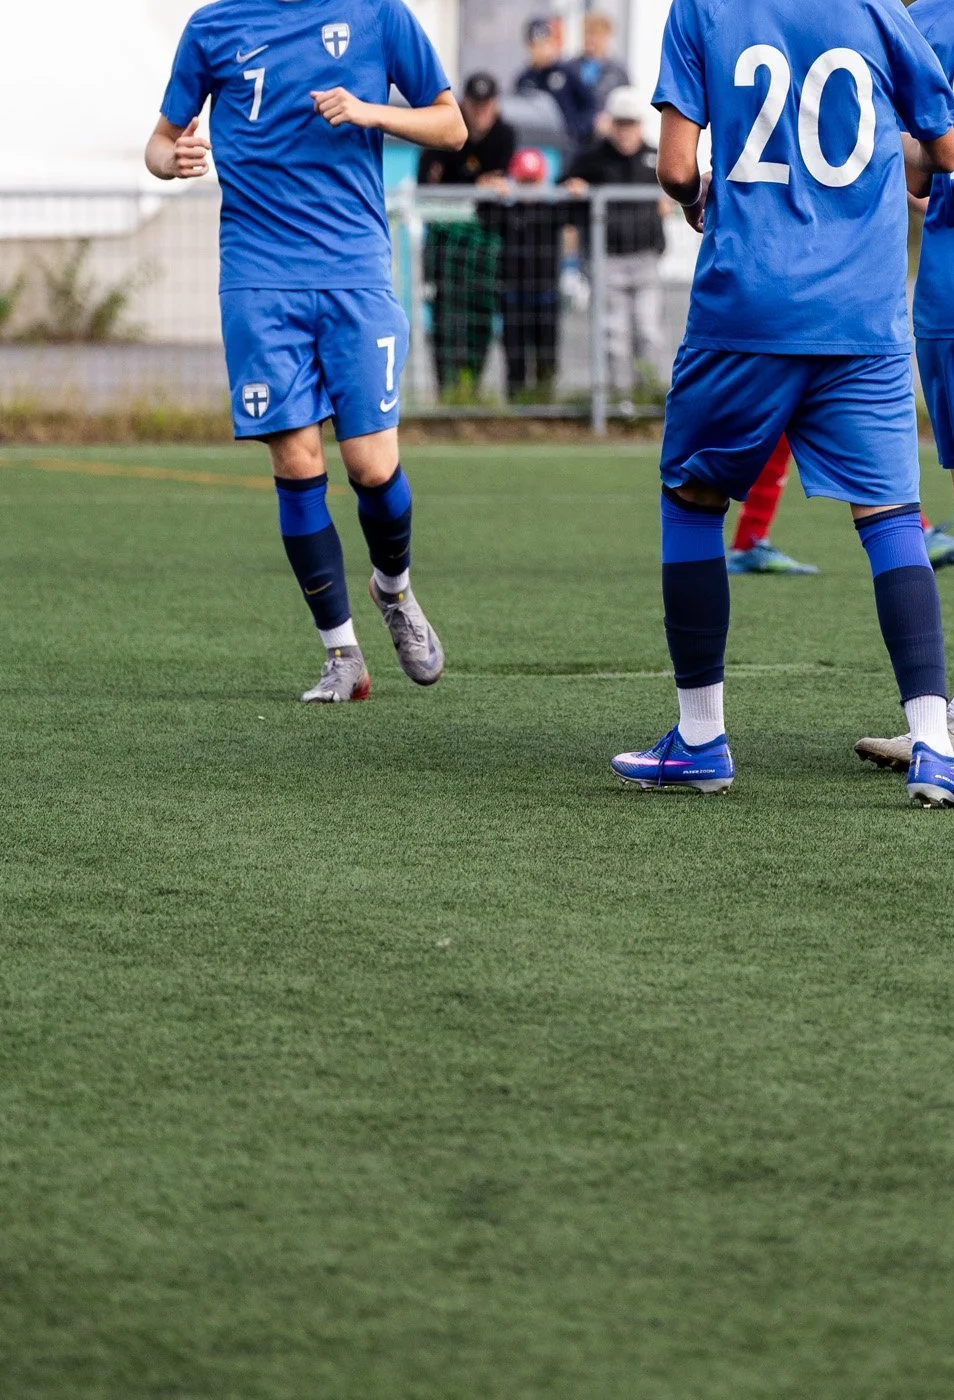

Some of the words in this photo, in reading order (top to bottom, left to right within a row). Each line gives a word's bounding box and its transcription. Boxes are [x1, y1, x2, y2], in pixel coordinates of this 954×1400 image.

[243, 67, 265, 121] 7
[726, 43, 876, 187] 20
[377, 336, 395, 391] 7
